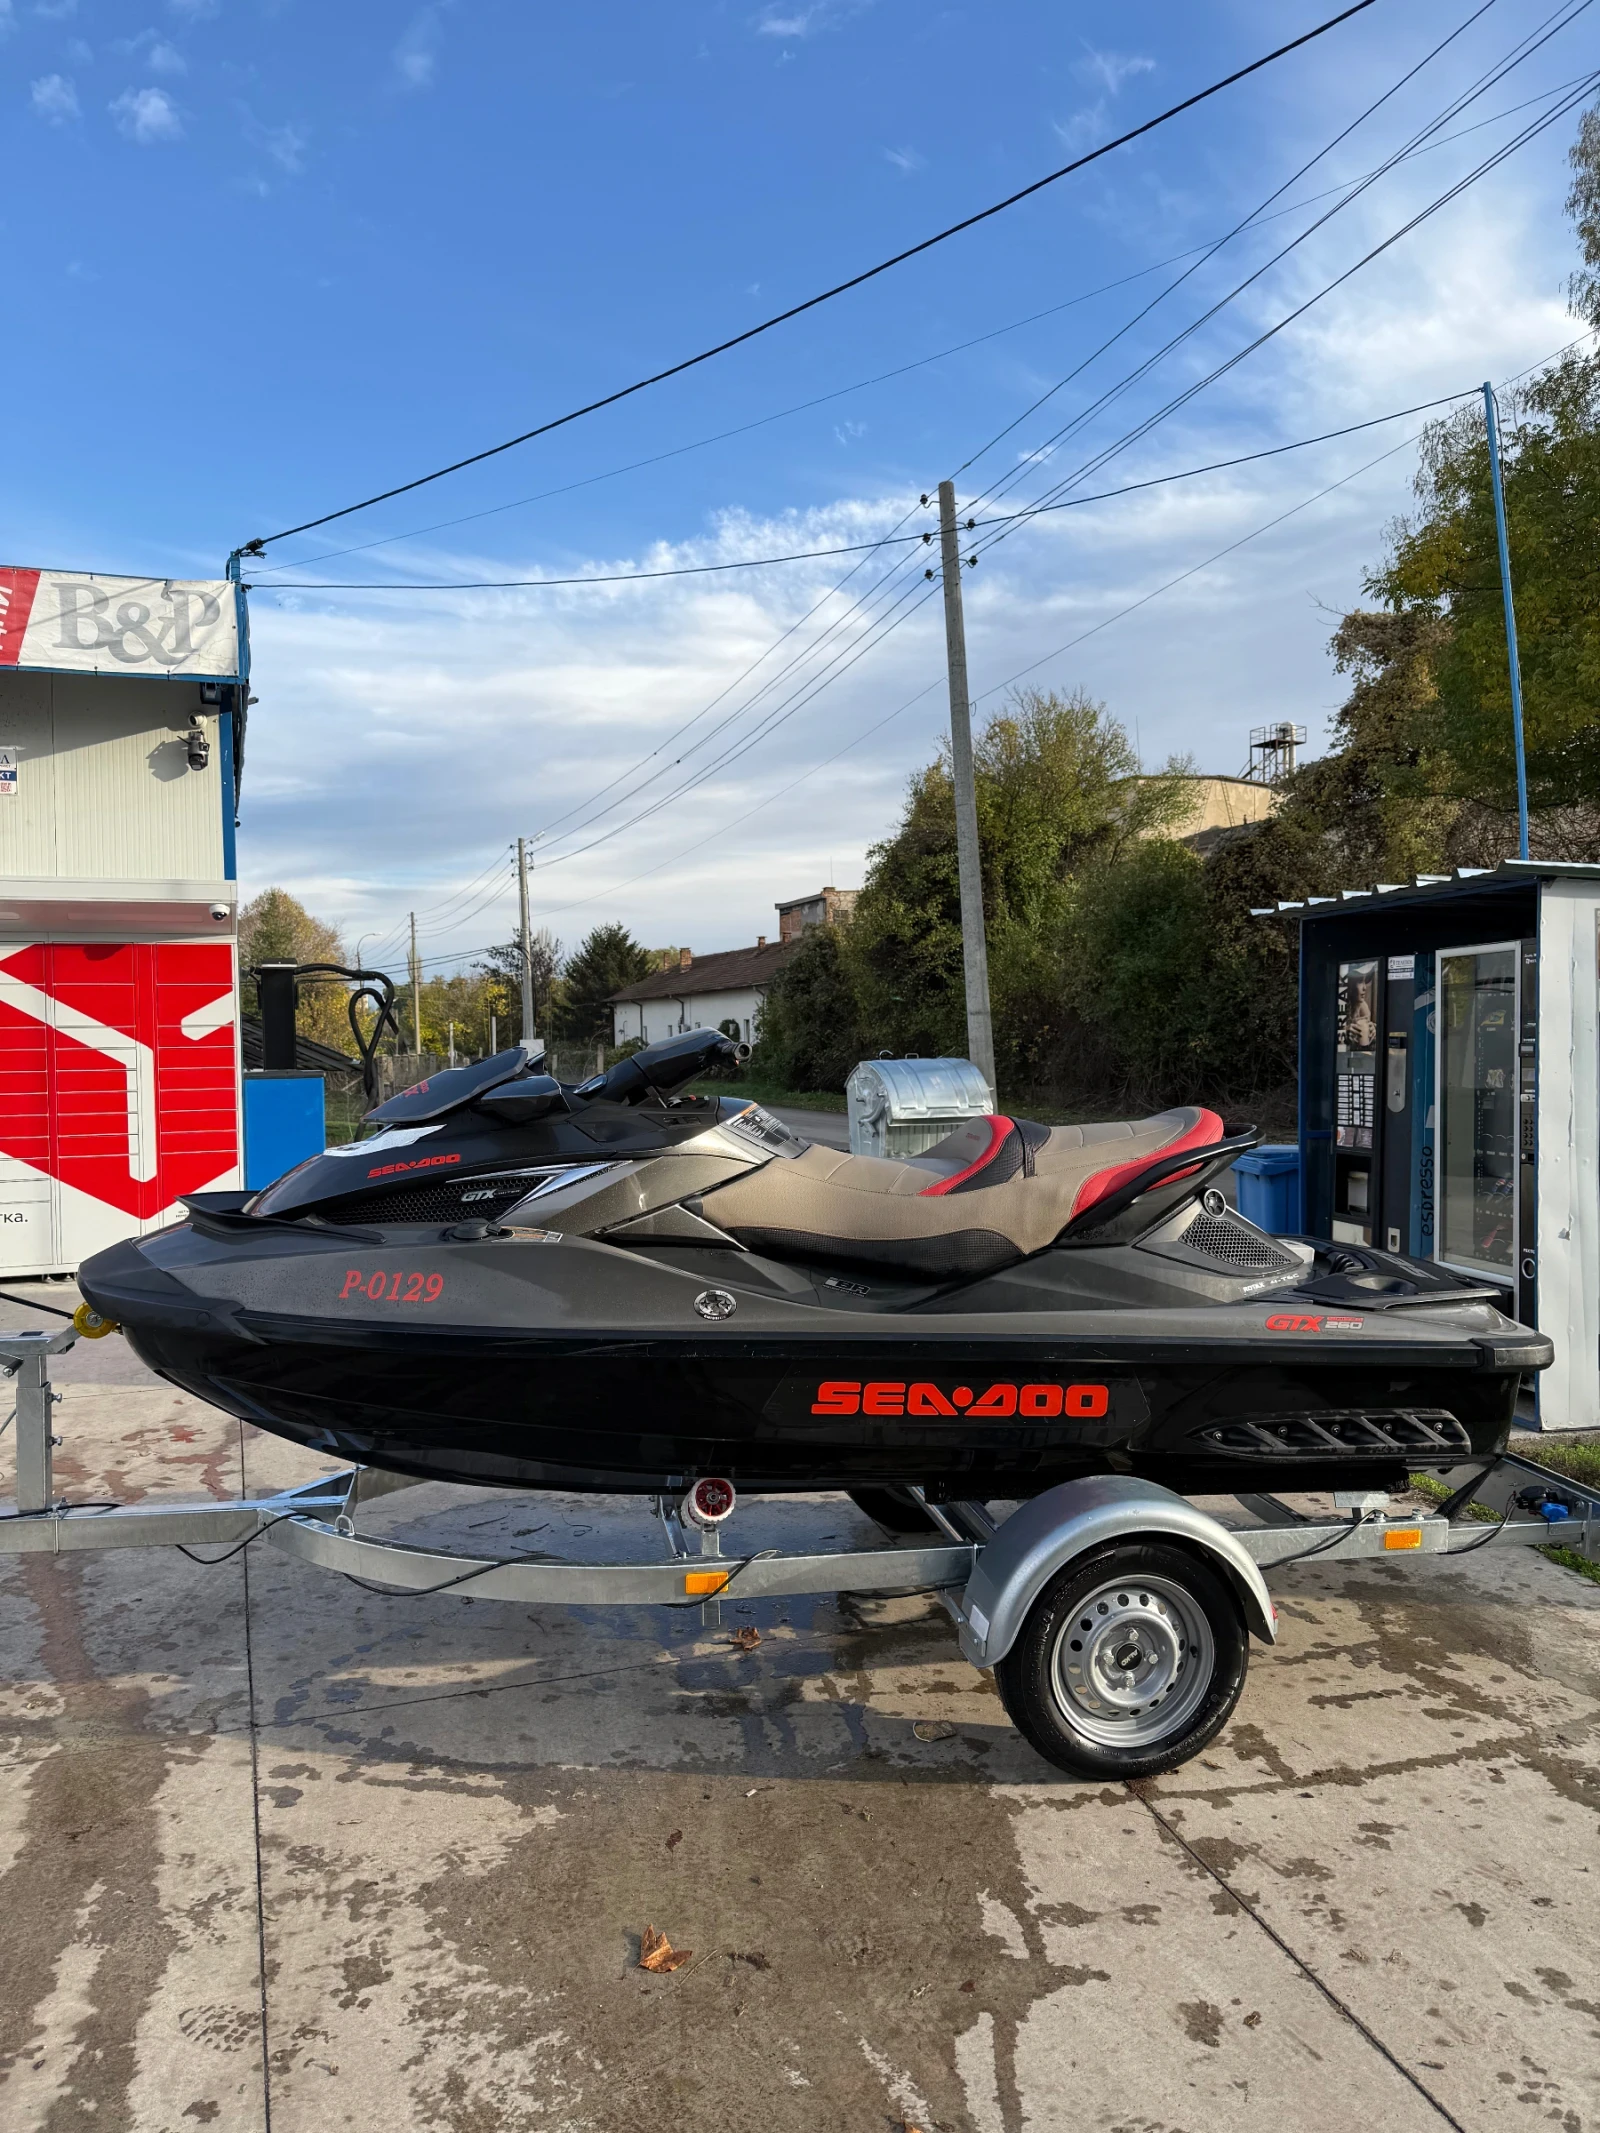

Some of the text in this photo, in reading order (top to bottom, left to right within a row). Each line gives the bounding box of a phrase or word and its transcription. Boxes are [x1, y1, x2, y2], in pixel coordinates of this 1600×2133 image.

[51, 582, 221, 665] B&P
[461, 1188, 497, 1202] GTX
[1419, 1146, 1434, 1236] espresso
[1265, 1313, 1364, 1333] GTX 260
